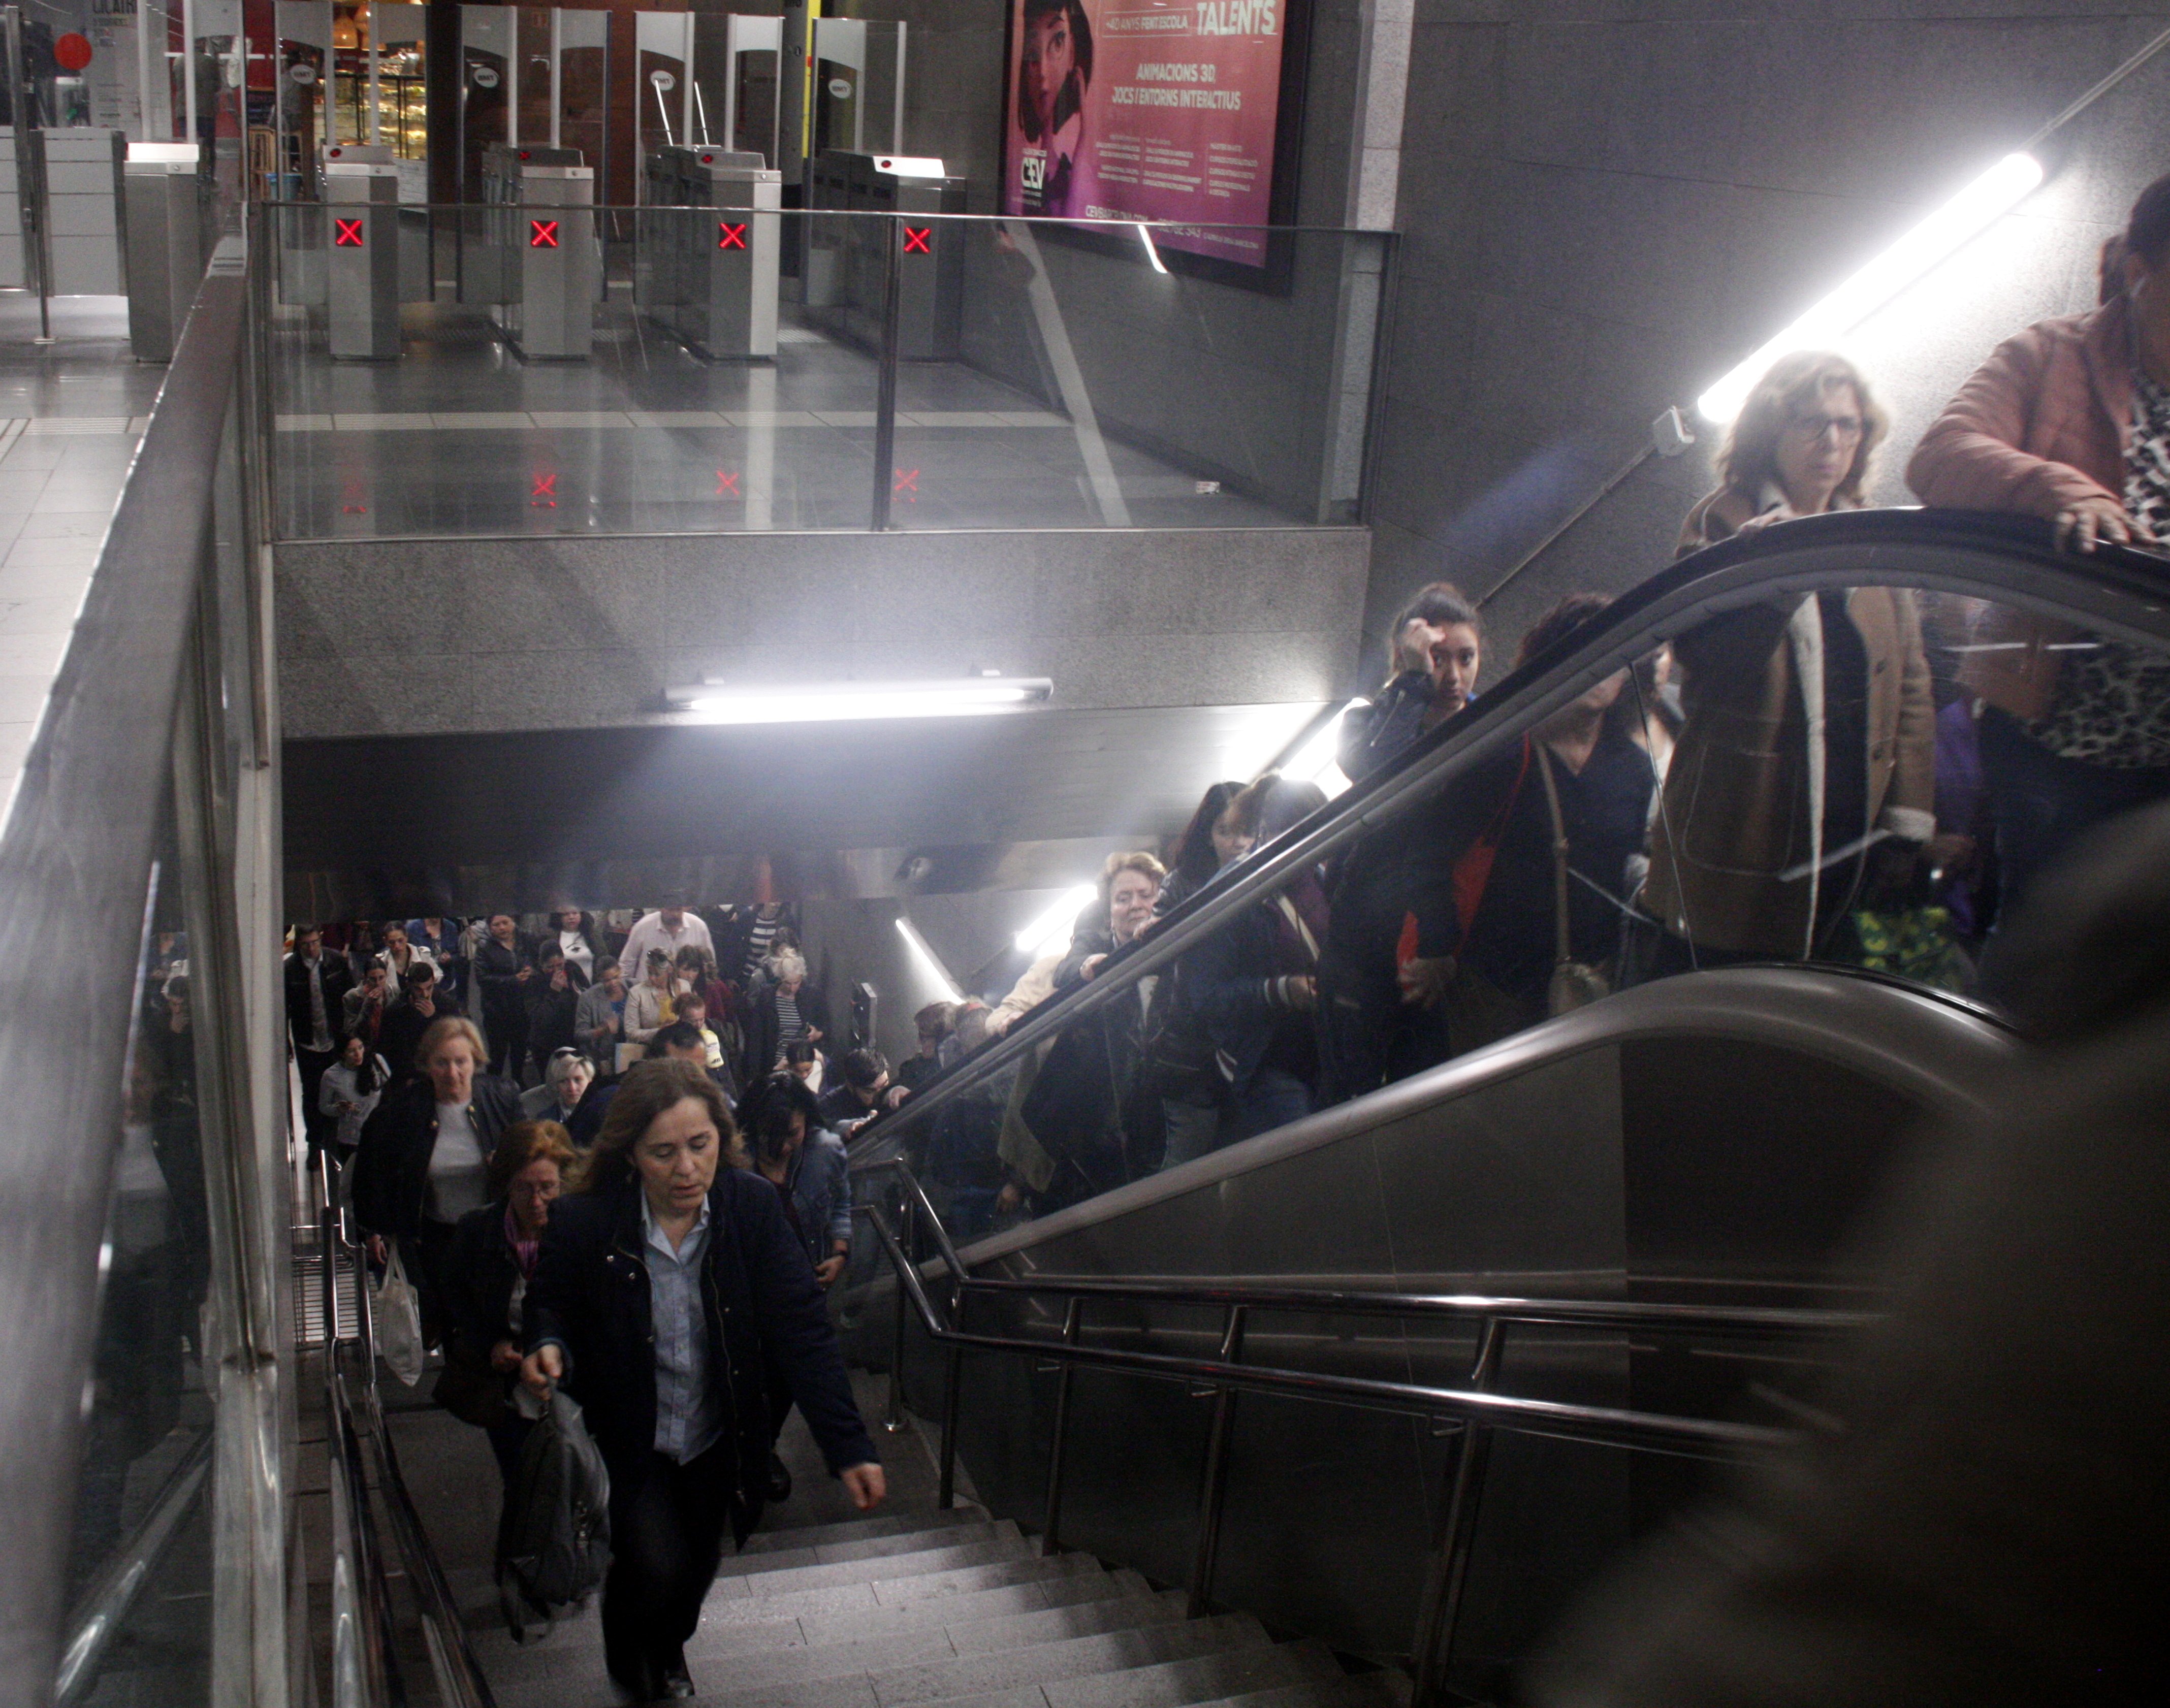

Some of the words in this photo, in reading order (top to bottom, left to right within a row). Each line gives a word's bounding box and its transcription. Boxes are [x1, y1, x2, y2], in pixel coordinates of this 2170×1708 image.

[1197, 1, 1276, 35] TALENTS
[1136, 63, 1198, 82] ANIMACIONS
[1112, 86, 1134, 105] JOCS
[1139, 87, 1178, 108] ENTORNS
[1179, 88, 1241, 110] INTERACTIUS
